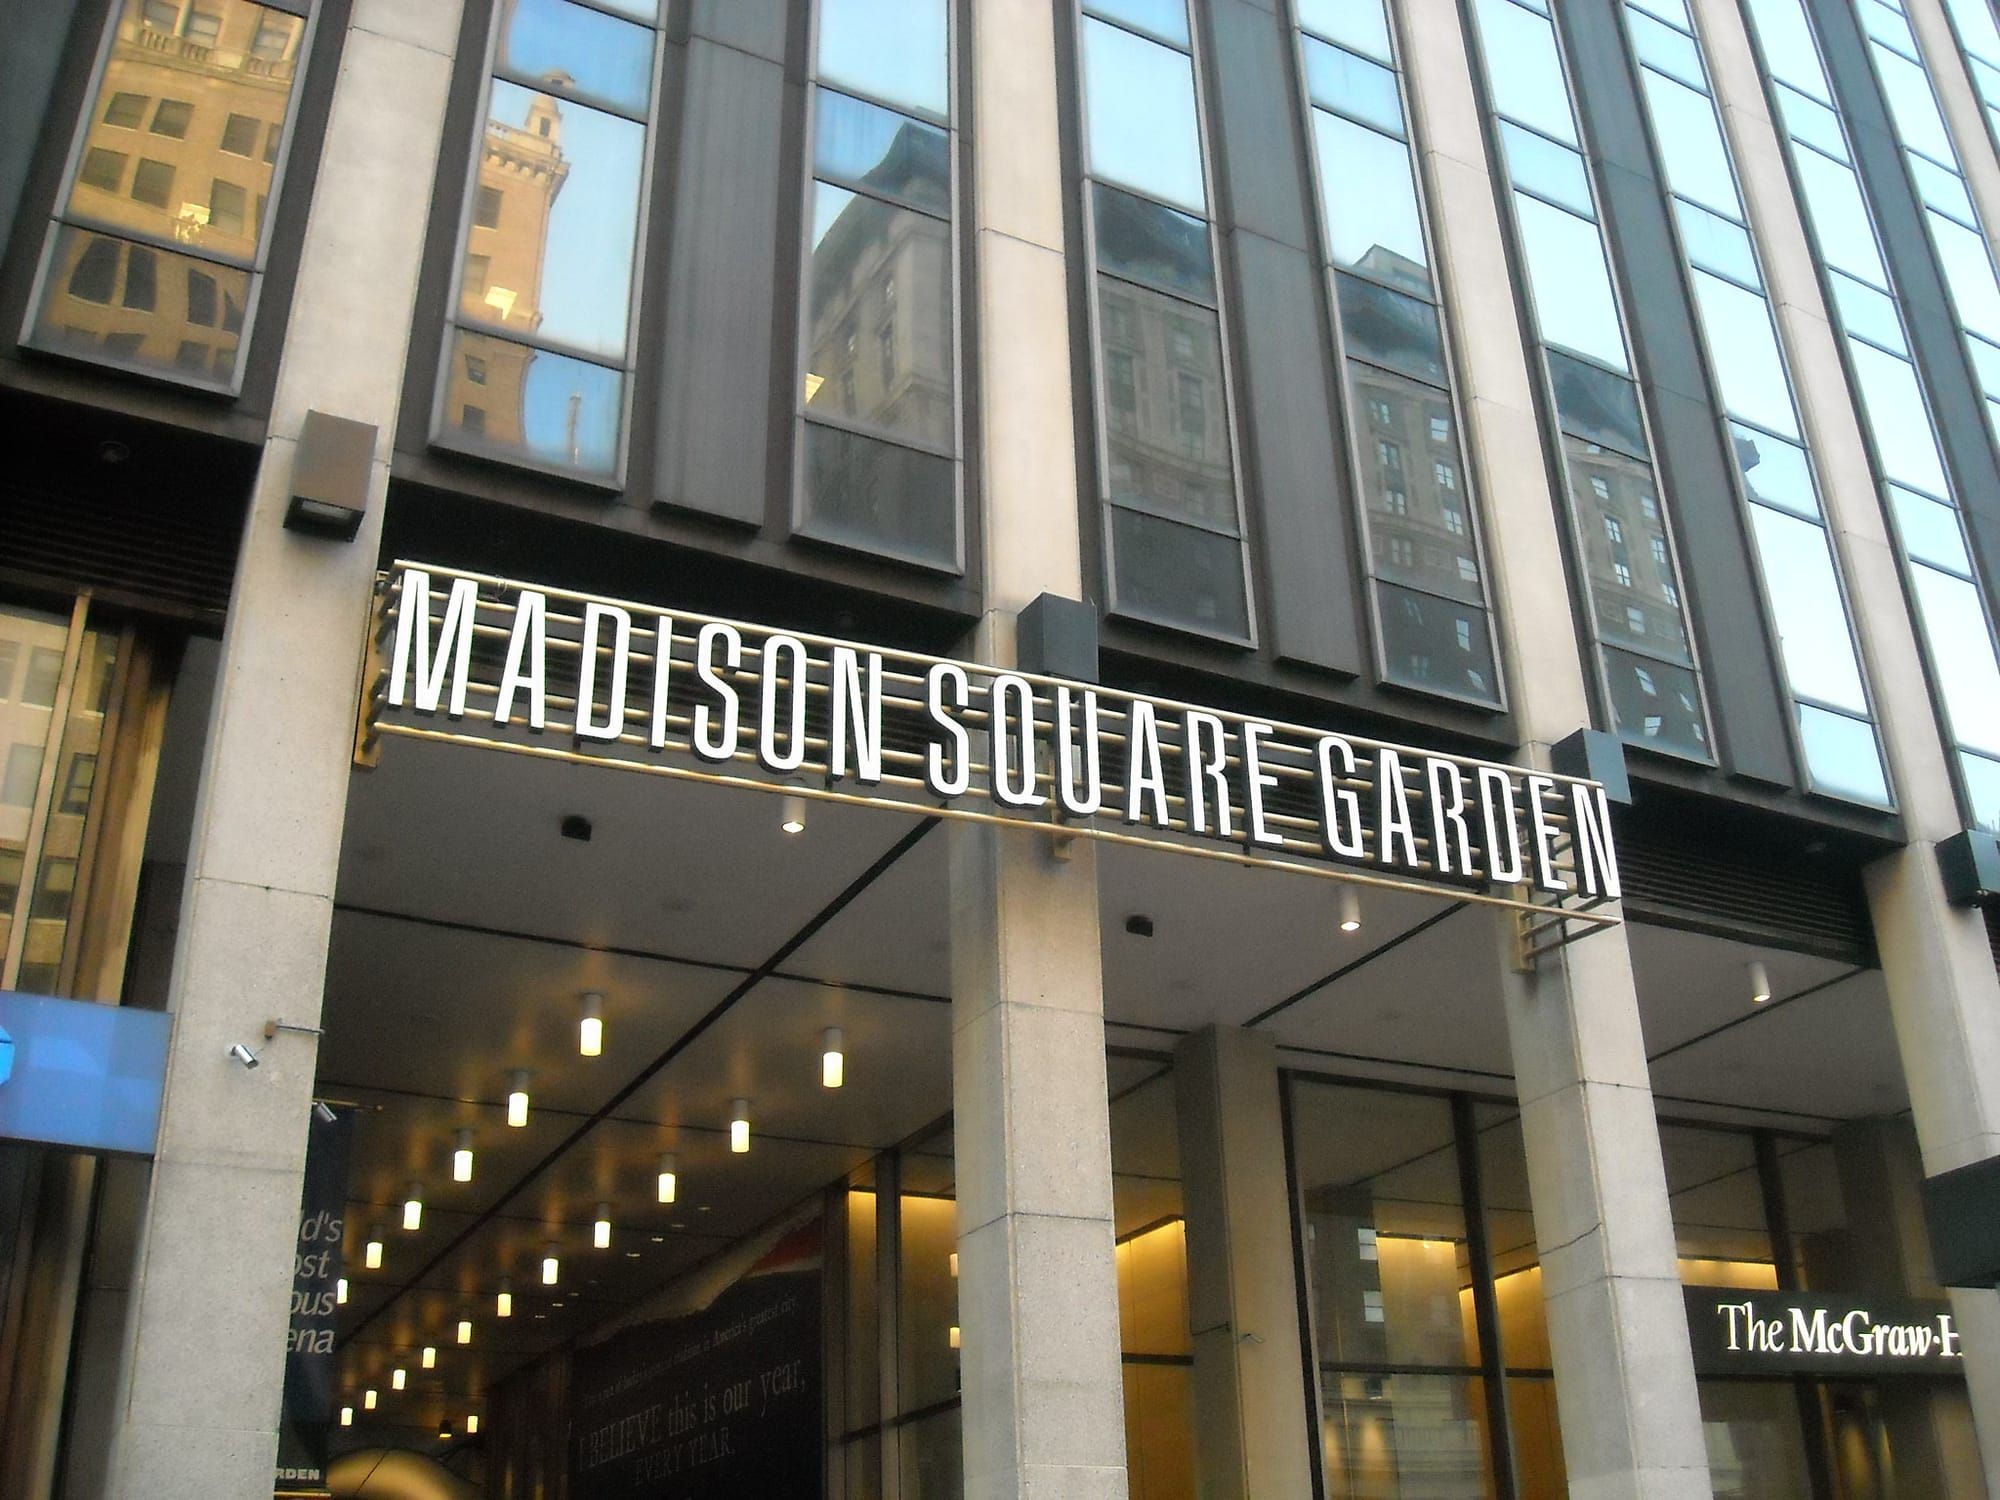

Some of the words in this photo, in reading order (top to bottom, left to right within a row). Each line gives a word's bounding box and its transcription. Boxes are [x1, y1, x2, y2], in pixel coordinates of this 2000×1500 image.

[388, 569, 883, 785] MADISON
[925, 662, 1284, 846] SQUARE
[1316, 735, 1622, 899] GARDEN
[301, 1208, 344, 1243] d's
[1717, 1301, 1784, 1352] The
[588, 1402, 662, 1469] BELIEVE
[668, 1390, 698, 1437] this
[703, 1381, 717, 1424] is
[722, 1380, 753, 1416] our
[634, 1442, 684, 1487] EVERY
